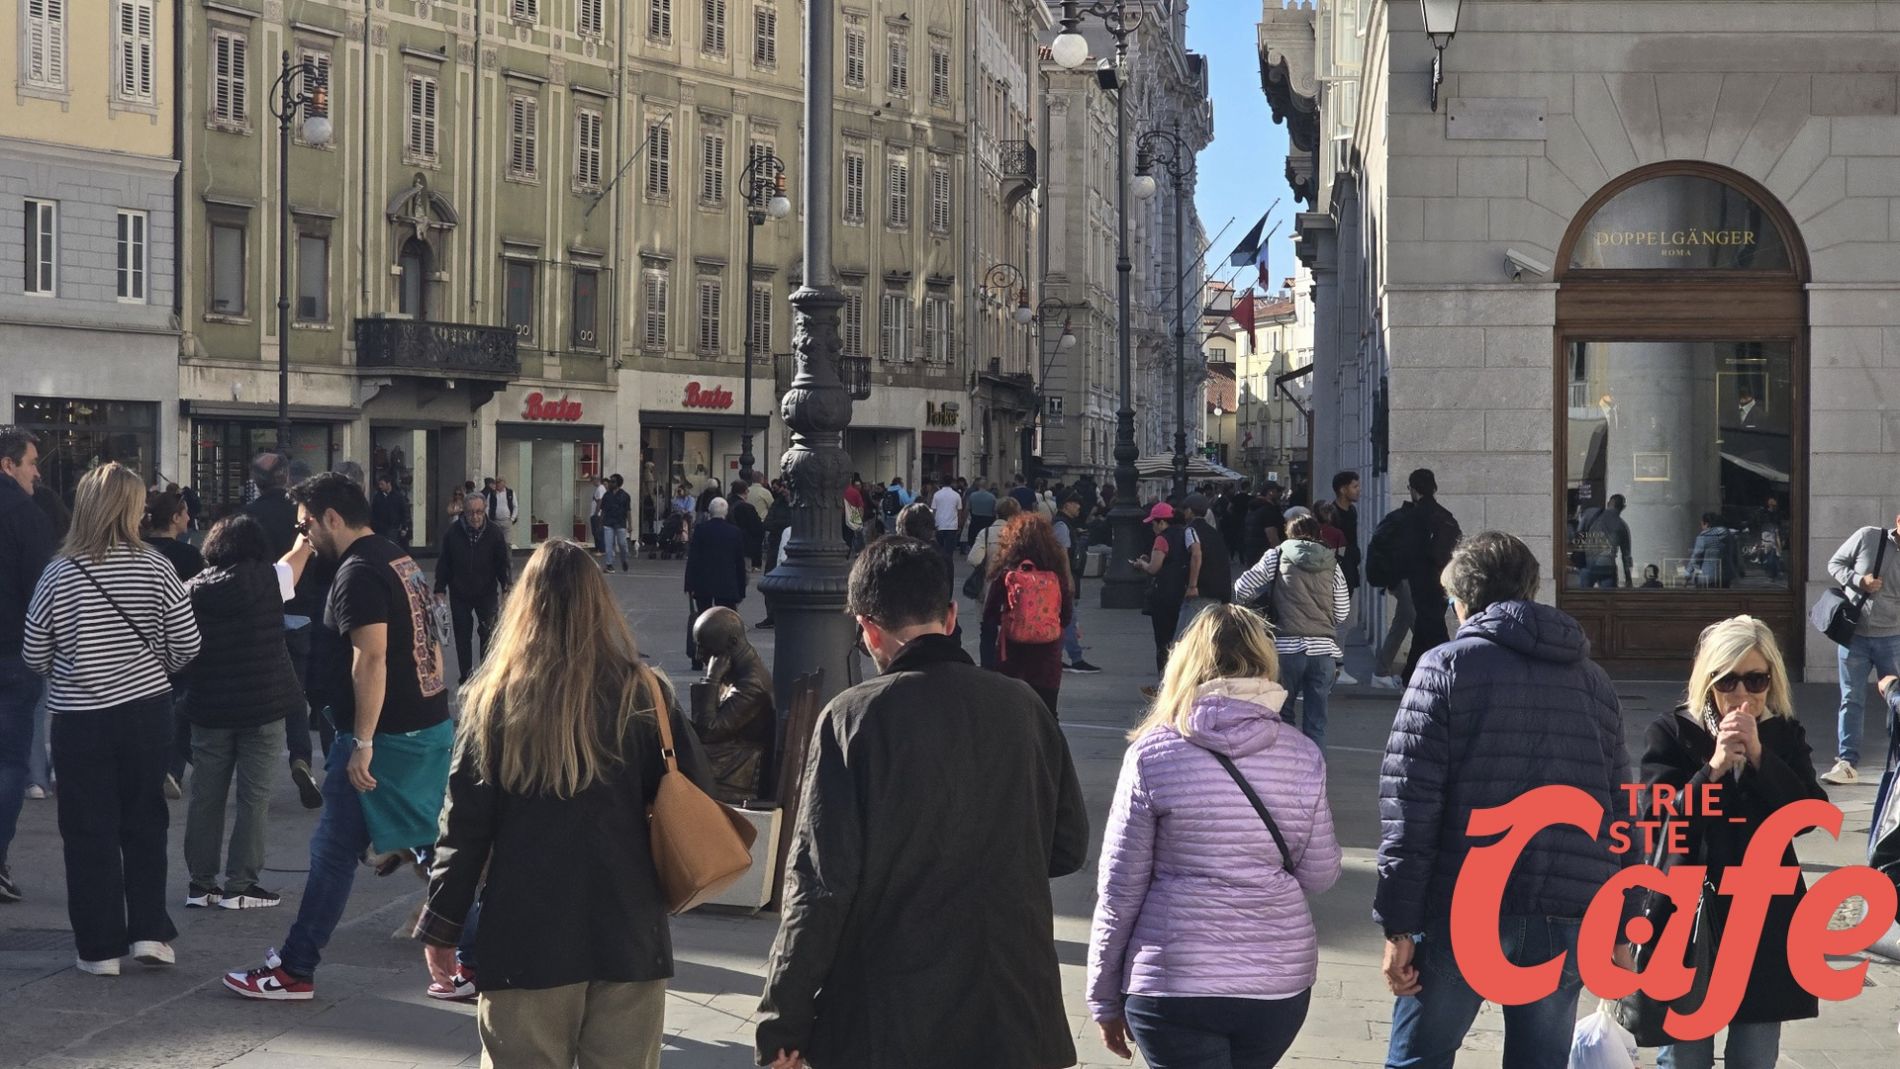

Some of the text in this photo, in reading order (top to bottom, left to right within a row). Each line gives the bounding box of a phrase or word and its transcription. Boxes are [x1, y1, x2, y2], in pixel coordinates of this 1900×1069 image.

[1596, 228, 1756, 246] DOPPELGÄNGER
[1661, 249, 1692, 257] ROMA
[521, 391, 583, 422] Bata
[683, 381, 734, 409] Bata
